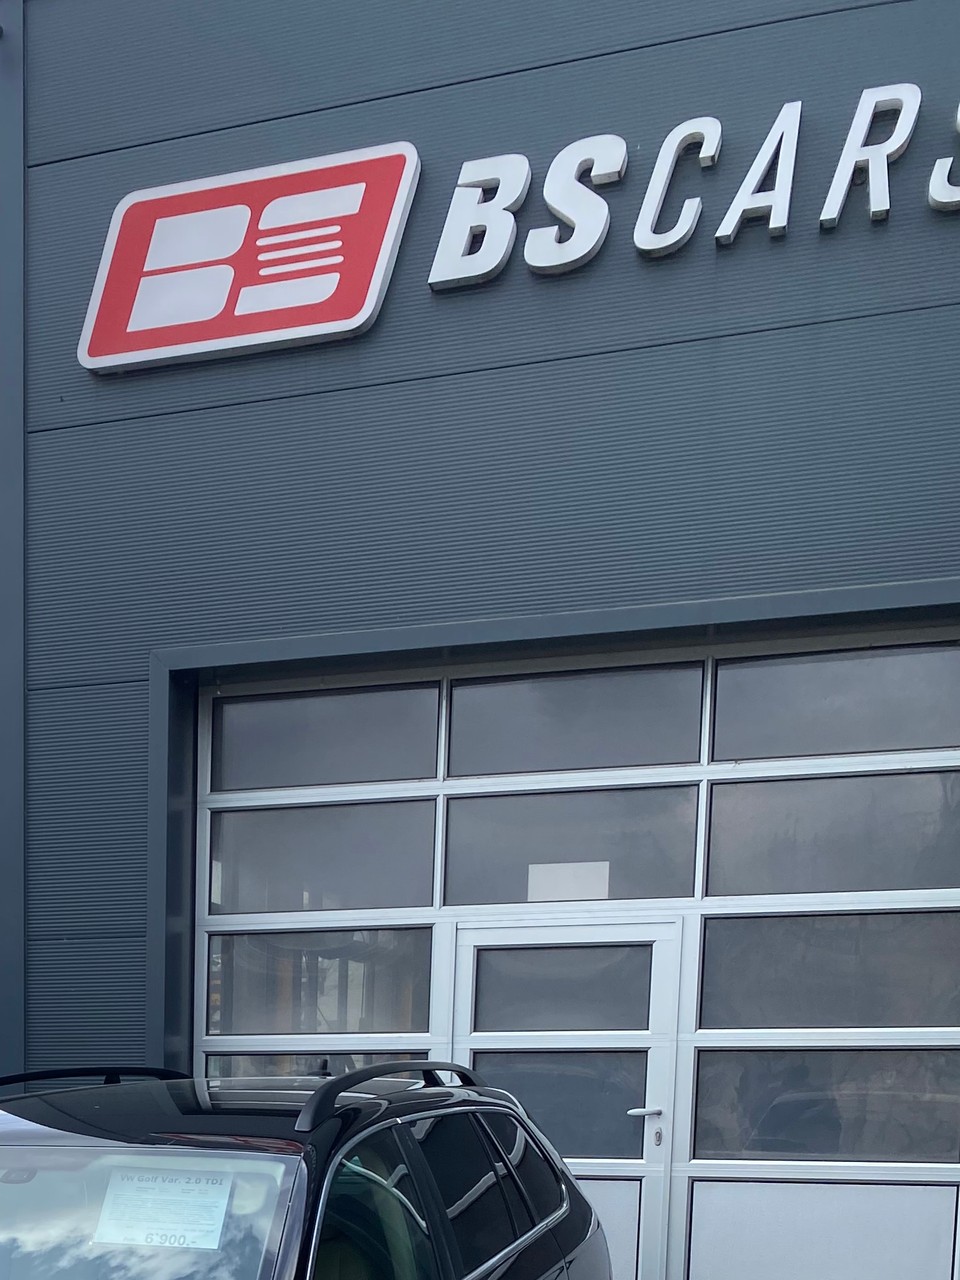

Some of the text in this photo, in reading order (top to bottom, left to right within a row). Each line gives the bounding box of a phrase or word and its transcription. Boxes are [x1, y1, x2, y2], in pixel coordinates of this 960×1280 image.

[120, 1174, 136, 1182] VW
[137, 1175, 159, 1183] Golf
[185, 1177, 201, 1185] 2.0
[205, 1178, 224, 1186] TDI
